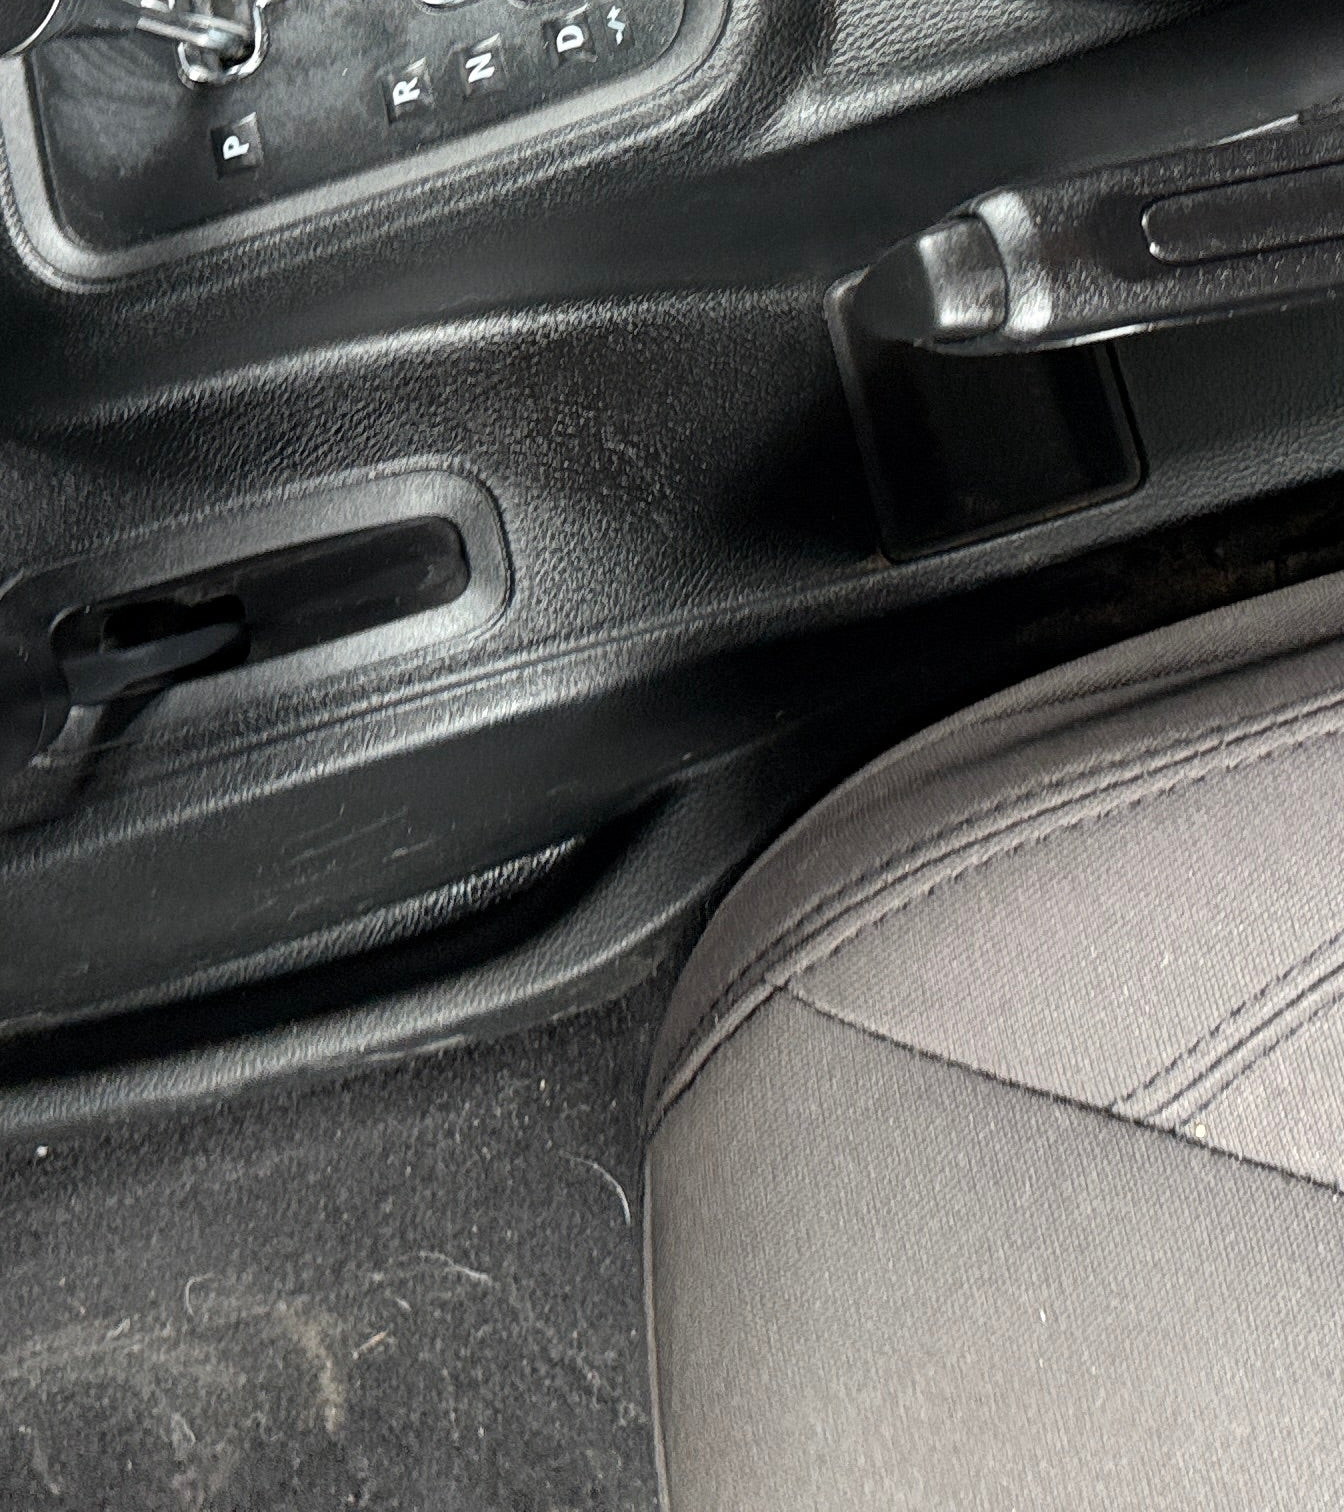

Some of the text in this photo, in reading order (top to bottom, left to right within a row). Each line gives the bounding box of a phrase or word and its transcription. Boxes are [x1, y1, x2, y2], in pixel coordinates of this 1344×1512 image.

[556, 25, 586, 53] D
[465, 51, 495, 83] N
[392, 77, 422, 107] R
[222, 135, 251, 160] P
